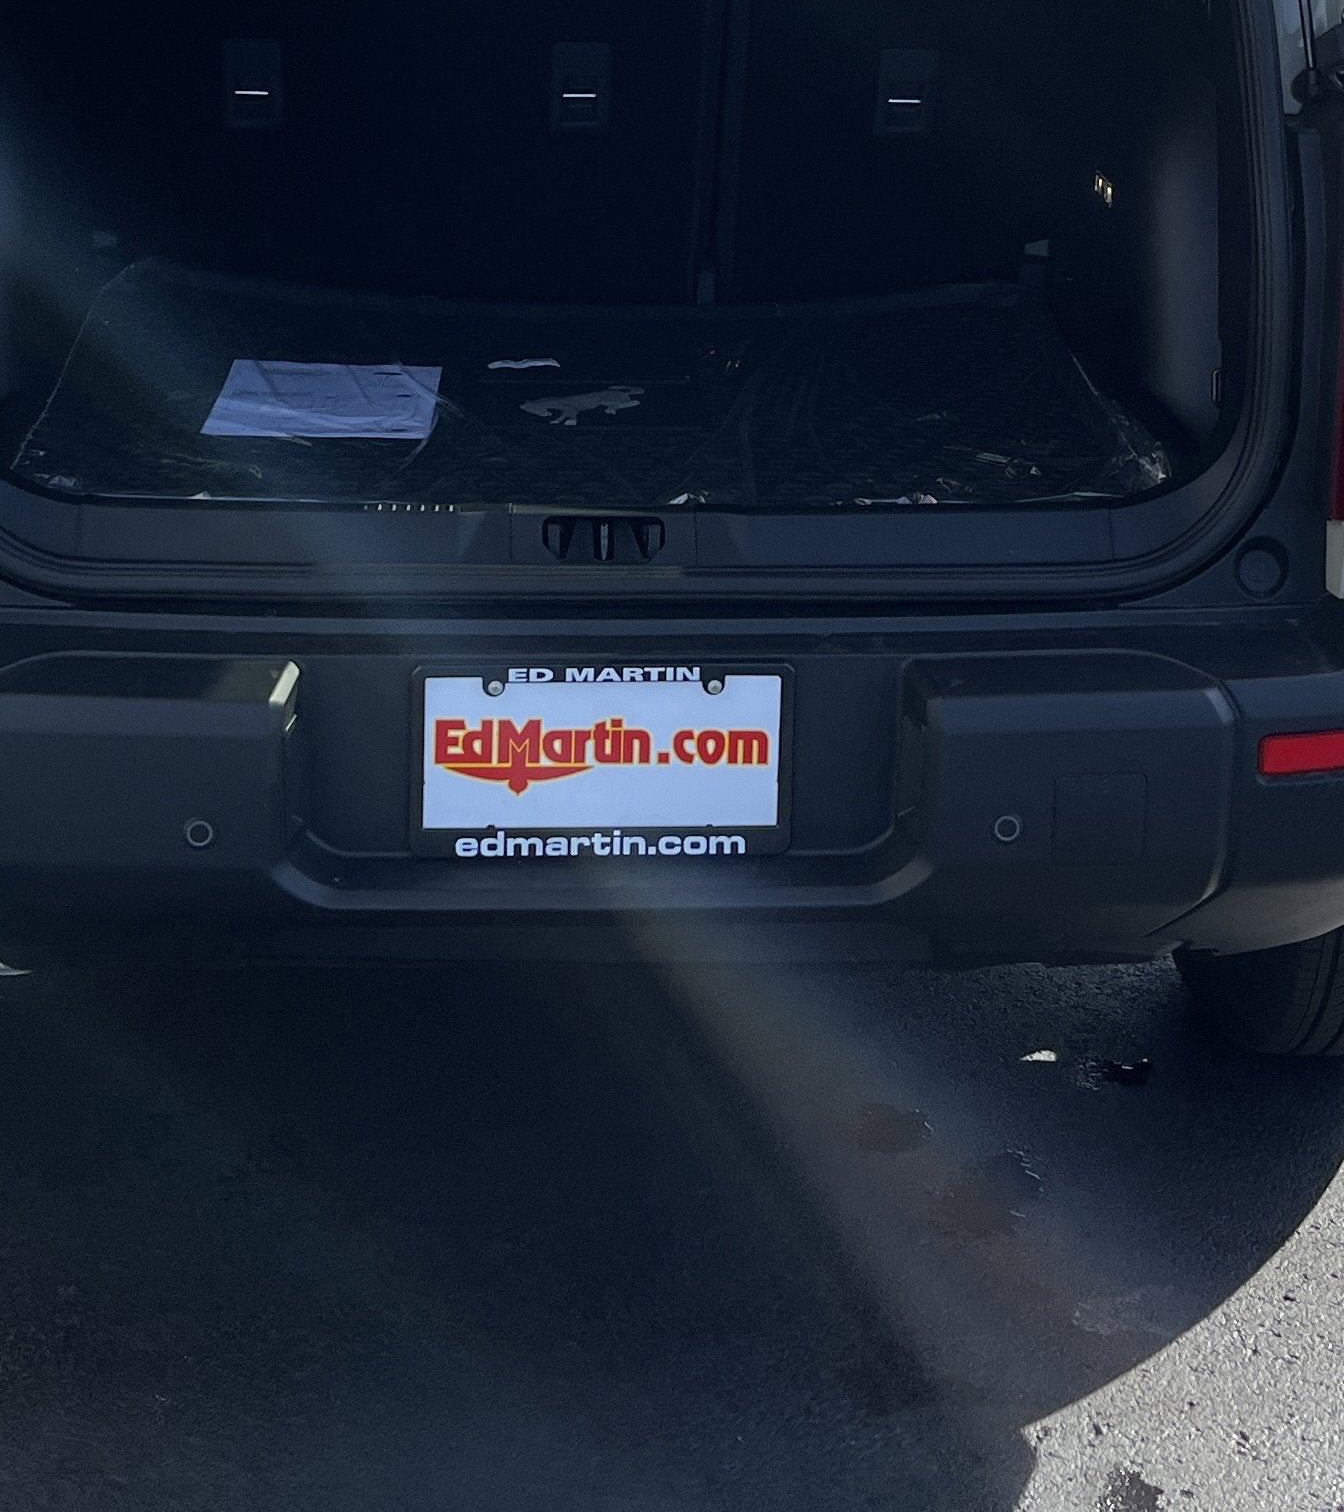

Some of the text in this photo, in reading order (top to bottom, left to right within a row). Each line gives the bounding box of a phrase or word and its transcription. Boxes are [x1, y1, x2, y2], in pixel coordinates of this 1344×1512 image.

[508, 666, 701, 683] ED MARTIN
[434, 718, 769, 766] EdMartin.com
[455, 830, 746, 857] edmartin.com
